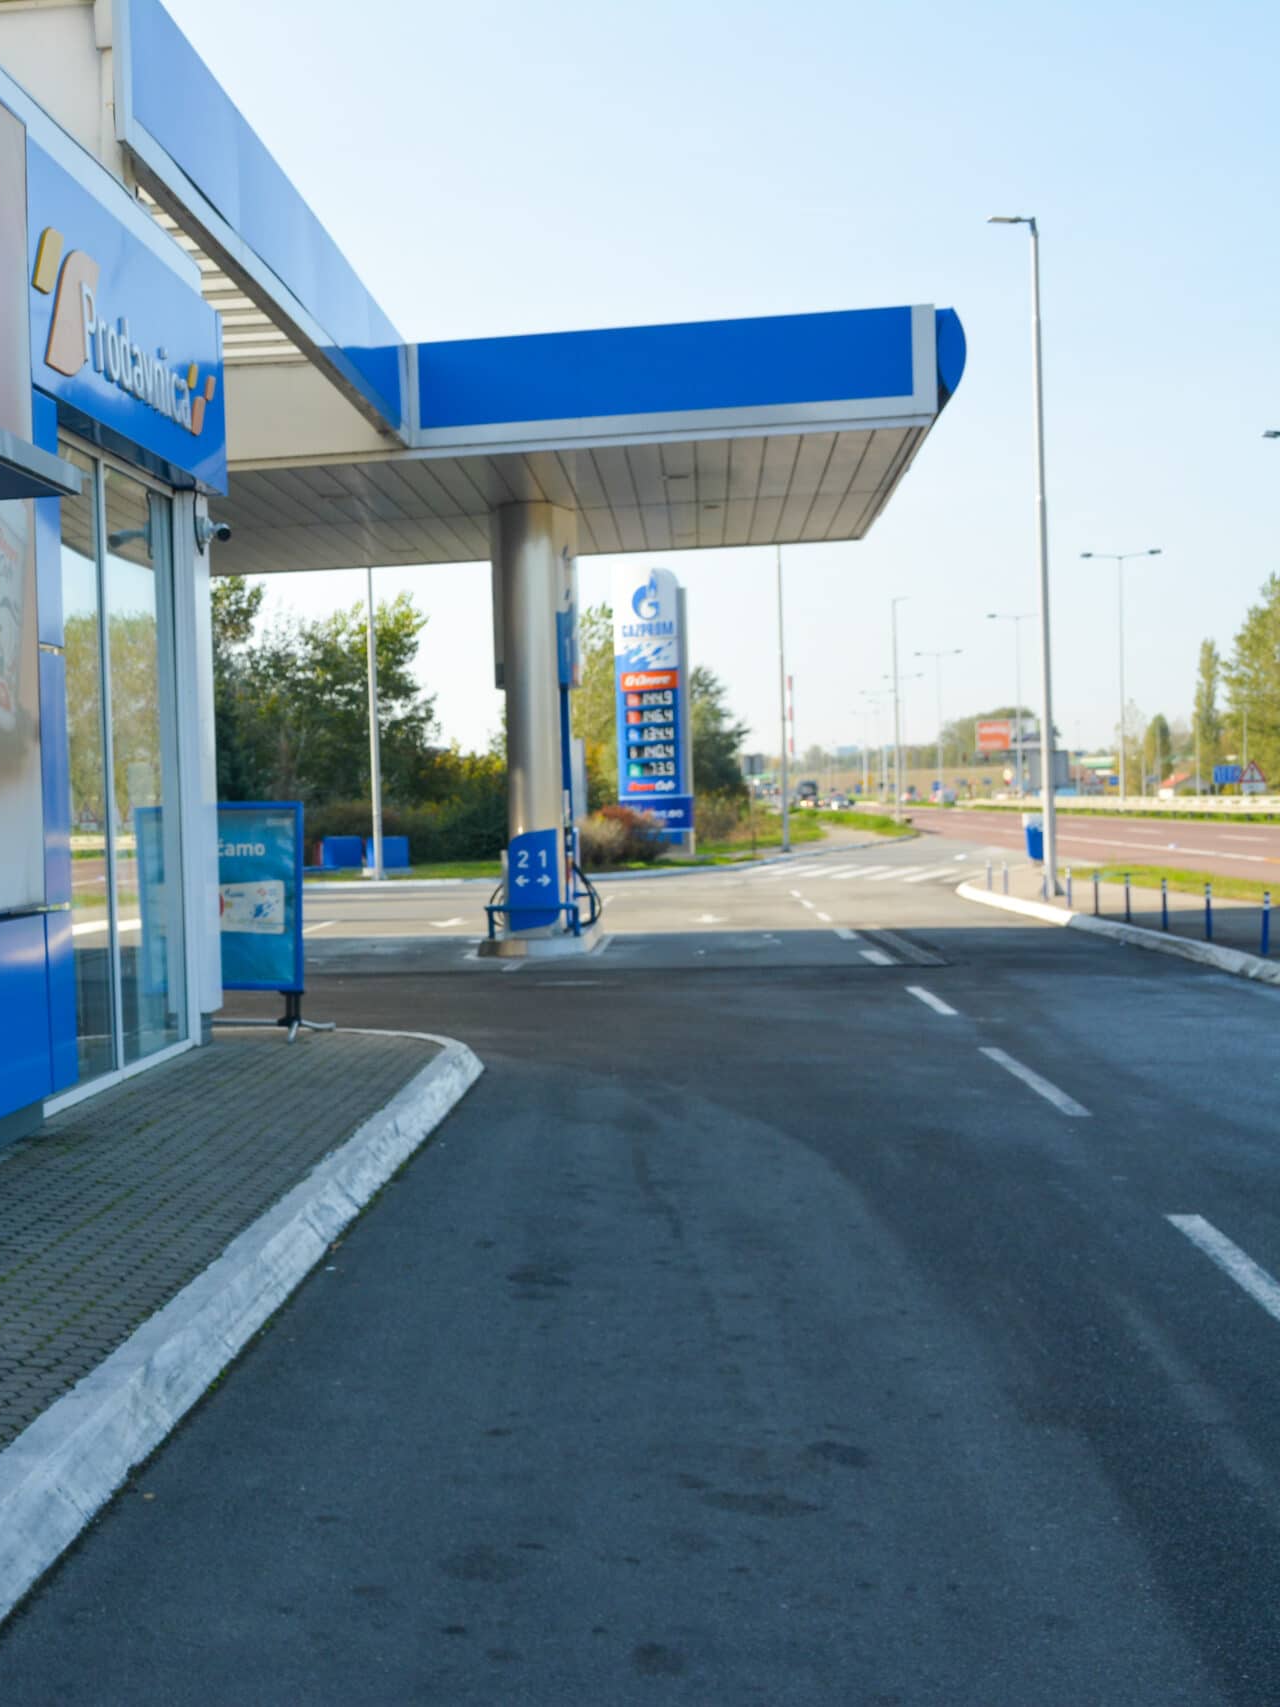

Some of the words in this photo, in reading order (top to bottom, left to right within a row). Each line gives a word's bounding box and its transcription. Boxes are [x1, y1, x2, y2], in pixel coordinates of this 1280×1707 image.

[80, 280, 193, 430] Prodavnica
[518, 850, 529, 868] 2
[538, 849, 548, 867] 1
